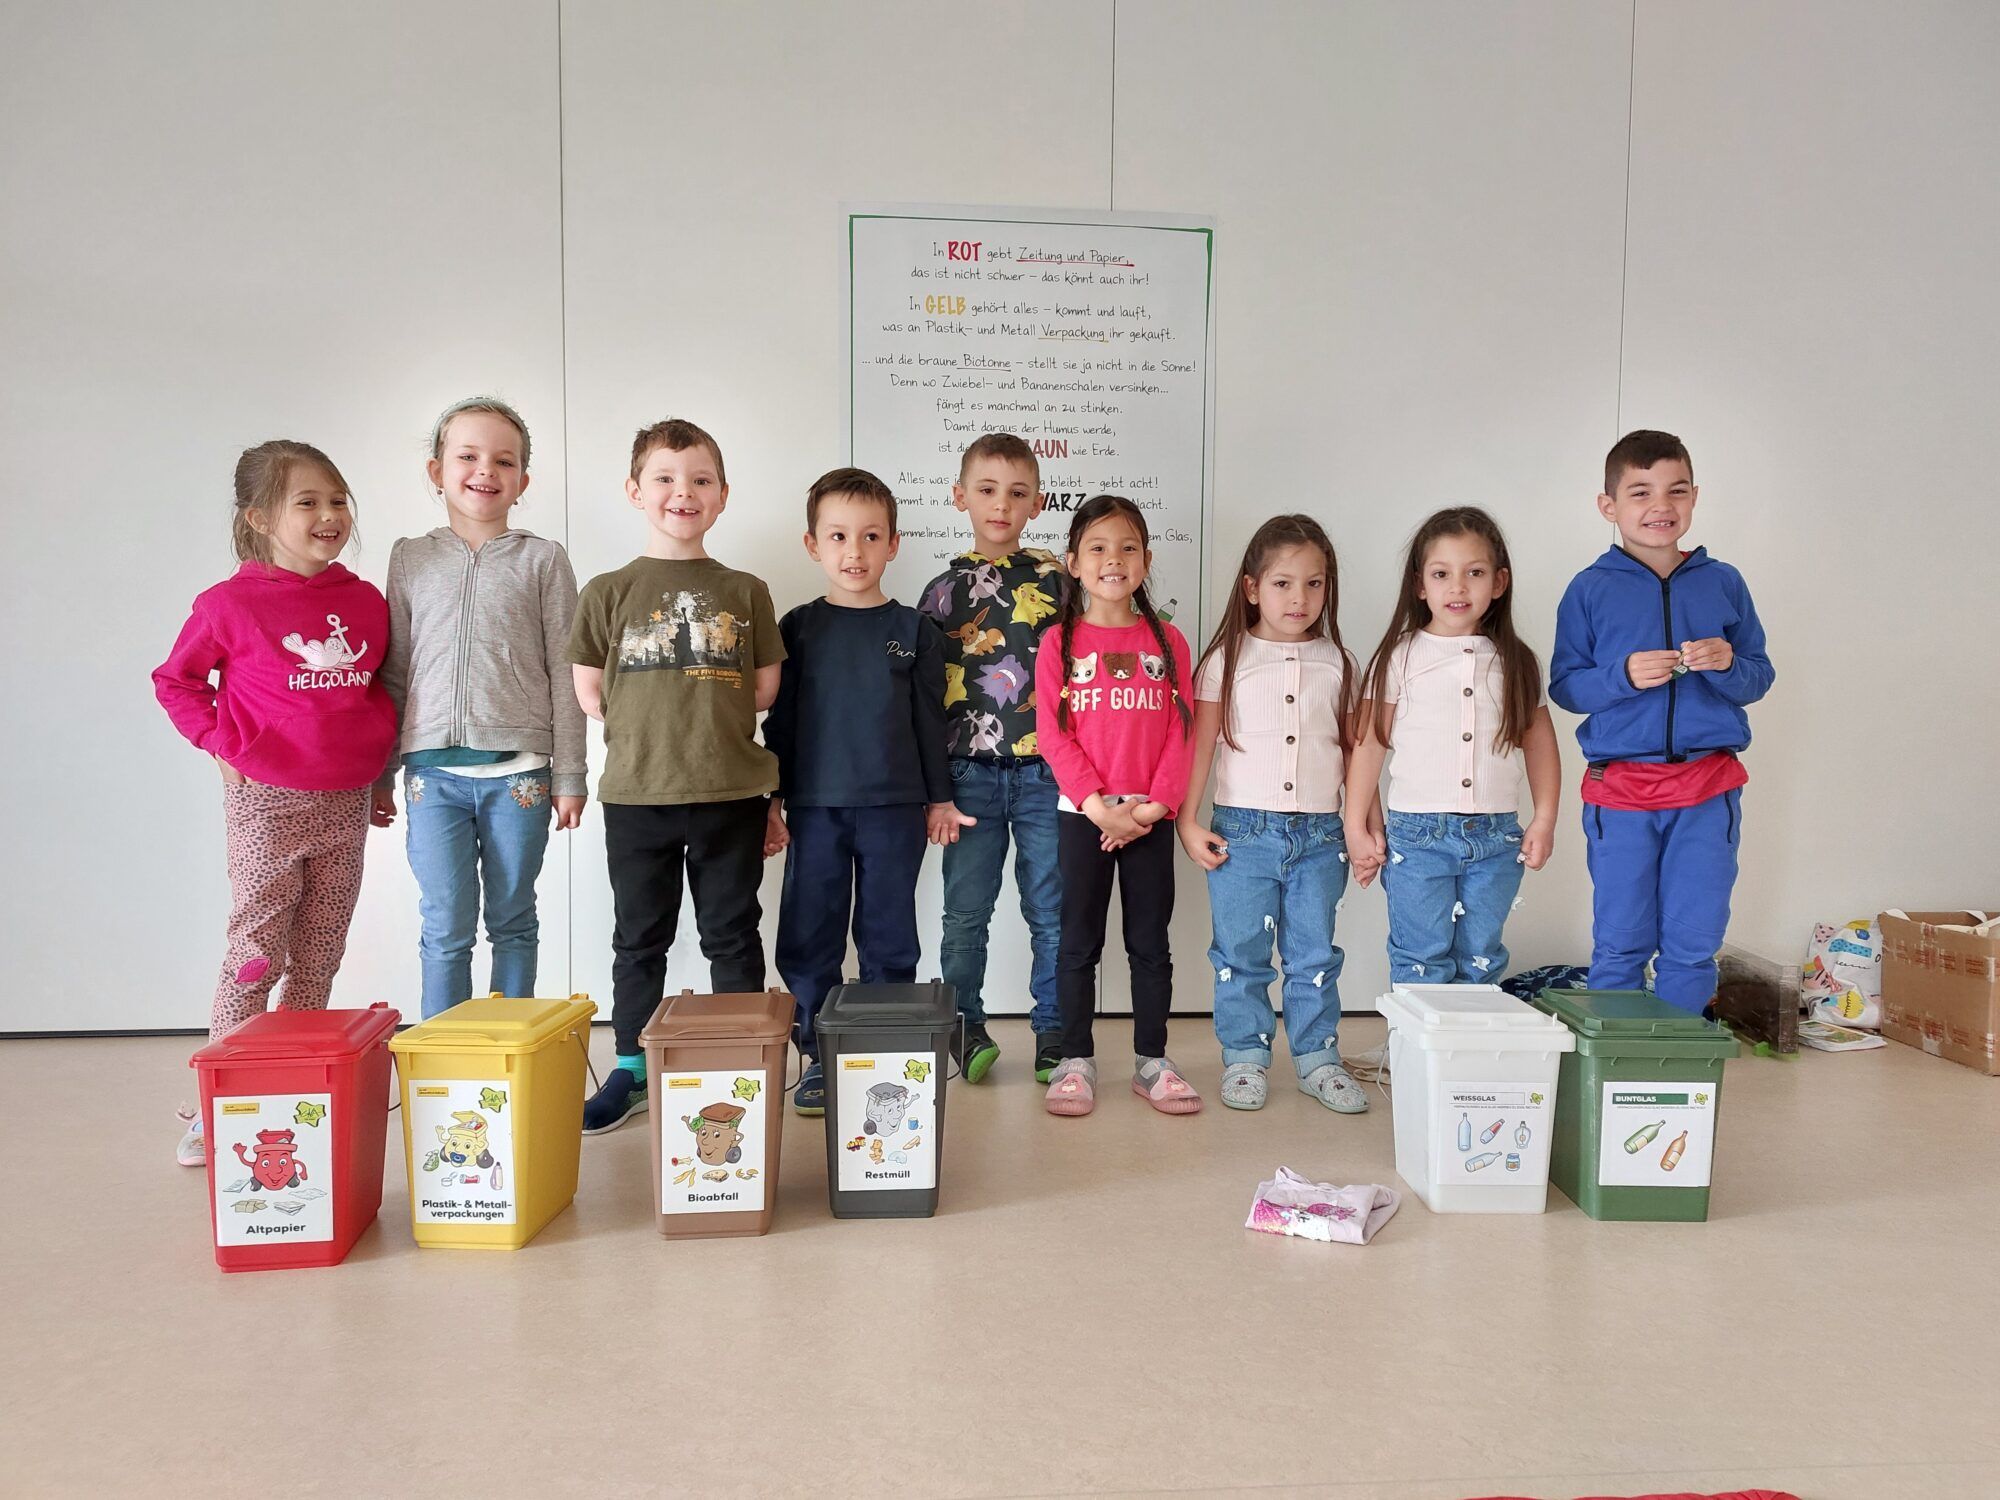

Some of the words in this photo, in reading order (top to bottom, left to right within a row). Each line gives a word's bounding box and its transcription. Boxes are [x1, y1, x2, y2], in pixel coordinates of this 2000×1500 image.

[933, 241, 945, 257] In
[947, 240, 983, 262] ROT
[986, 247, 1013, 263] gebt
[1018, 246, 1063, 265] Zeitung
[1066, 250, 1085, 262] und
[1088, 249, 1130, 267] Papier,
[910, 265, 930, 278] das
[934, 266, 950, 279] ist
[954, 267, 982, 280] nicht
[986, 269, 1026, 281] schwer
[1041, 270, 1060, 283] das
[1064, 270, 1095, 286] könnt
[1099, 272, 1125, 285] auch
[1129, 272, 1150, 286] ihr!
[909, 295, 921, 311] In
[925, 294, 967, 315] GELB
[971, 301, 1009, 317] gehört
[1013, 301, 1039, 315] alles
[1055, 302, 1092, 318] kommt
[1096, 305, 1116, 318] und
[1119, 304, 1152, 321] lauft,
[882, 324, 904, 333] was
[907, 324, 921, 333] an
[977, 323, 996, 336] und
[1000, 323, 1036, 336] Metall
[1041, 323, 1105, 342] Verpackung
[1109, 327, 1125, 339] ihr
[1129, 327, 1176, 343] gekauft.
[875, 352, 894, 365] und
[898, 353, 913, 366] die
[918, 353, 958, 367] braune
[963, 353, 1012, 369] Biotonne
[1027, 356, 1058, 369] stellt
[1062, 360, 1078, 370] sie
[1080, 358, 1092, 374] ja
[1096, 358, 1123, 372] nicht
[1128, 360, 1138, 372] in
[1141, 360, 1156, 372] die
[1160, 360, 1197, 373] Sonne!
[890, 373, 918, 388] Denn
[922, 378, 937, 388] wo
[997, 378, 1016, 390] und
[1020, 376, 1105, 392] Bananenschalen
[936, 397, 966, 414] fängt
[970, 402, 984, 411] es
[987, 400, 1040, 413] manchmal
[1044, 403, 1057, 413] an
[1061, 403, 1076, 413] zu
[1080, 401, 1124, 416] stinken.
[943, 418, 977, 432] Damit
[980, 420, 1018, 433] daraus
[1021, 421, 1040, 434] der
[1043, 419, 1079, 434] Humus
[1082, 421, 1117, 437] werde,
[938, 440, 952, 453] ist
[1025, 438, 1068, 459] AUN
[1071, 445, 1088, 456] wie
[1092, 443, 1120, 456] Erde.
[898, 471, 925, 485] Alles
[929, 477, 950, 485] was
[1050, 474, 1083, 488] bleibt
[1099, 476, 1125, 492] gebt
[1129, 476, 1158, 489] acht!
[896, 494, 925, 506] ommt
[930, 495, 939, 506] in
[898, 526, 950, 538] ammelinsel
[953, 526, 975, 539] brin
[1021, 528, 1060, 544] ckungen
[1165, 528, 1193, 544] Glas,
[933, 549, 950, 560] wir
[288, 671, 372, 691] HELGOLAND
[1070, 688, 1104, 713] BFF
[1110, 687, 1164, 711] GOALS
[1615, 1095, 1657, 1103] BUNTGLAS
[865, 1170, 911, 1179] Restmüll
[422, 1199, 462, 1209] Plastik-
[464, 1200, 473, 1208] &
[474, 1200, 513, 1209] Metall-
[687, 1192, 739, 1203] Bioabfall
[430, 1209, 505, 1221] verpackungen
[246, 1223, 307, 1236] Altpapier
